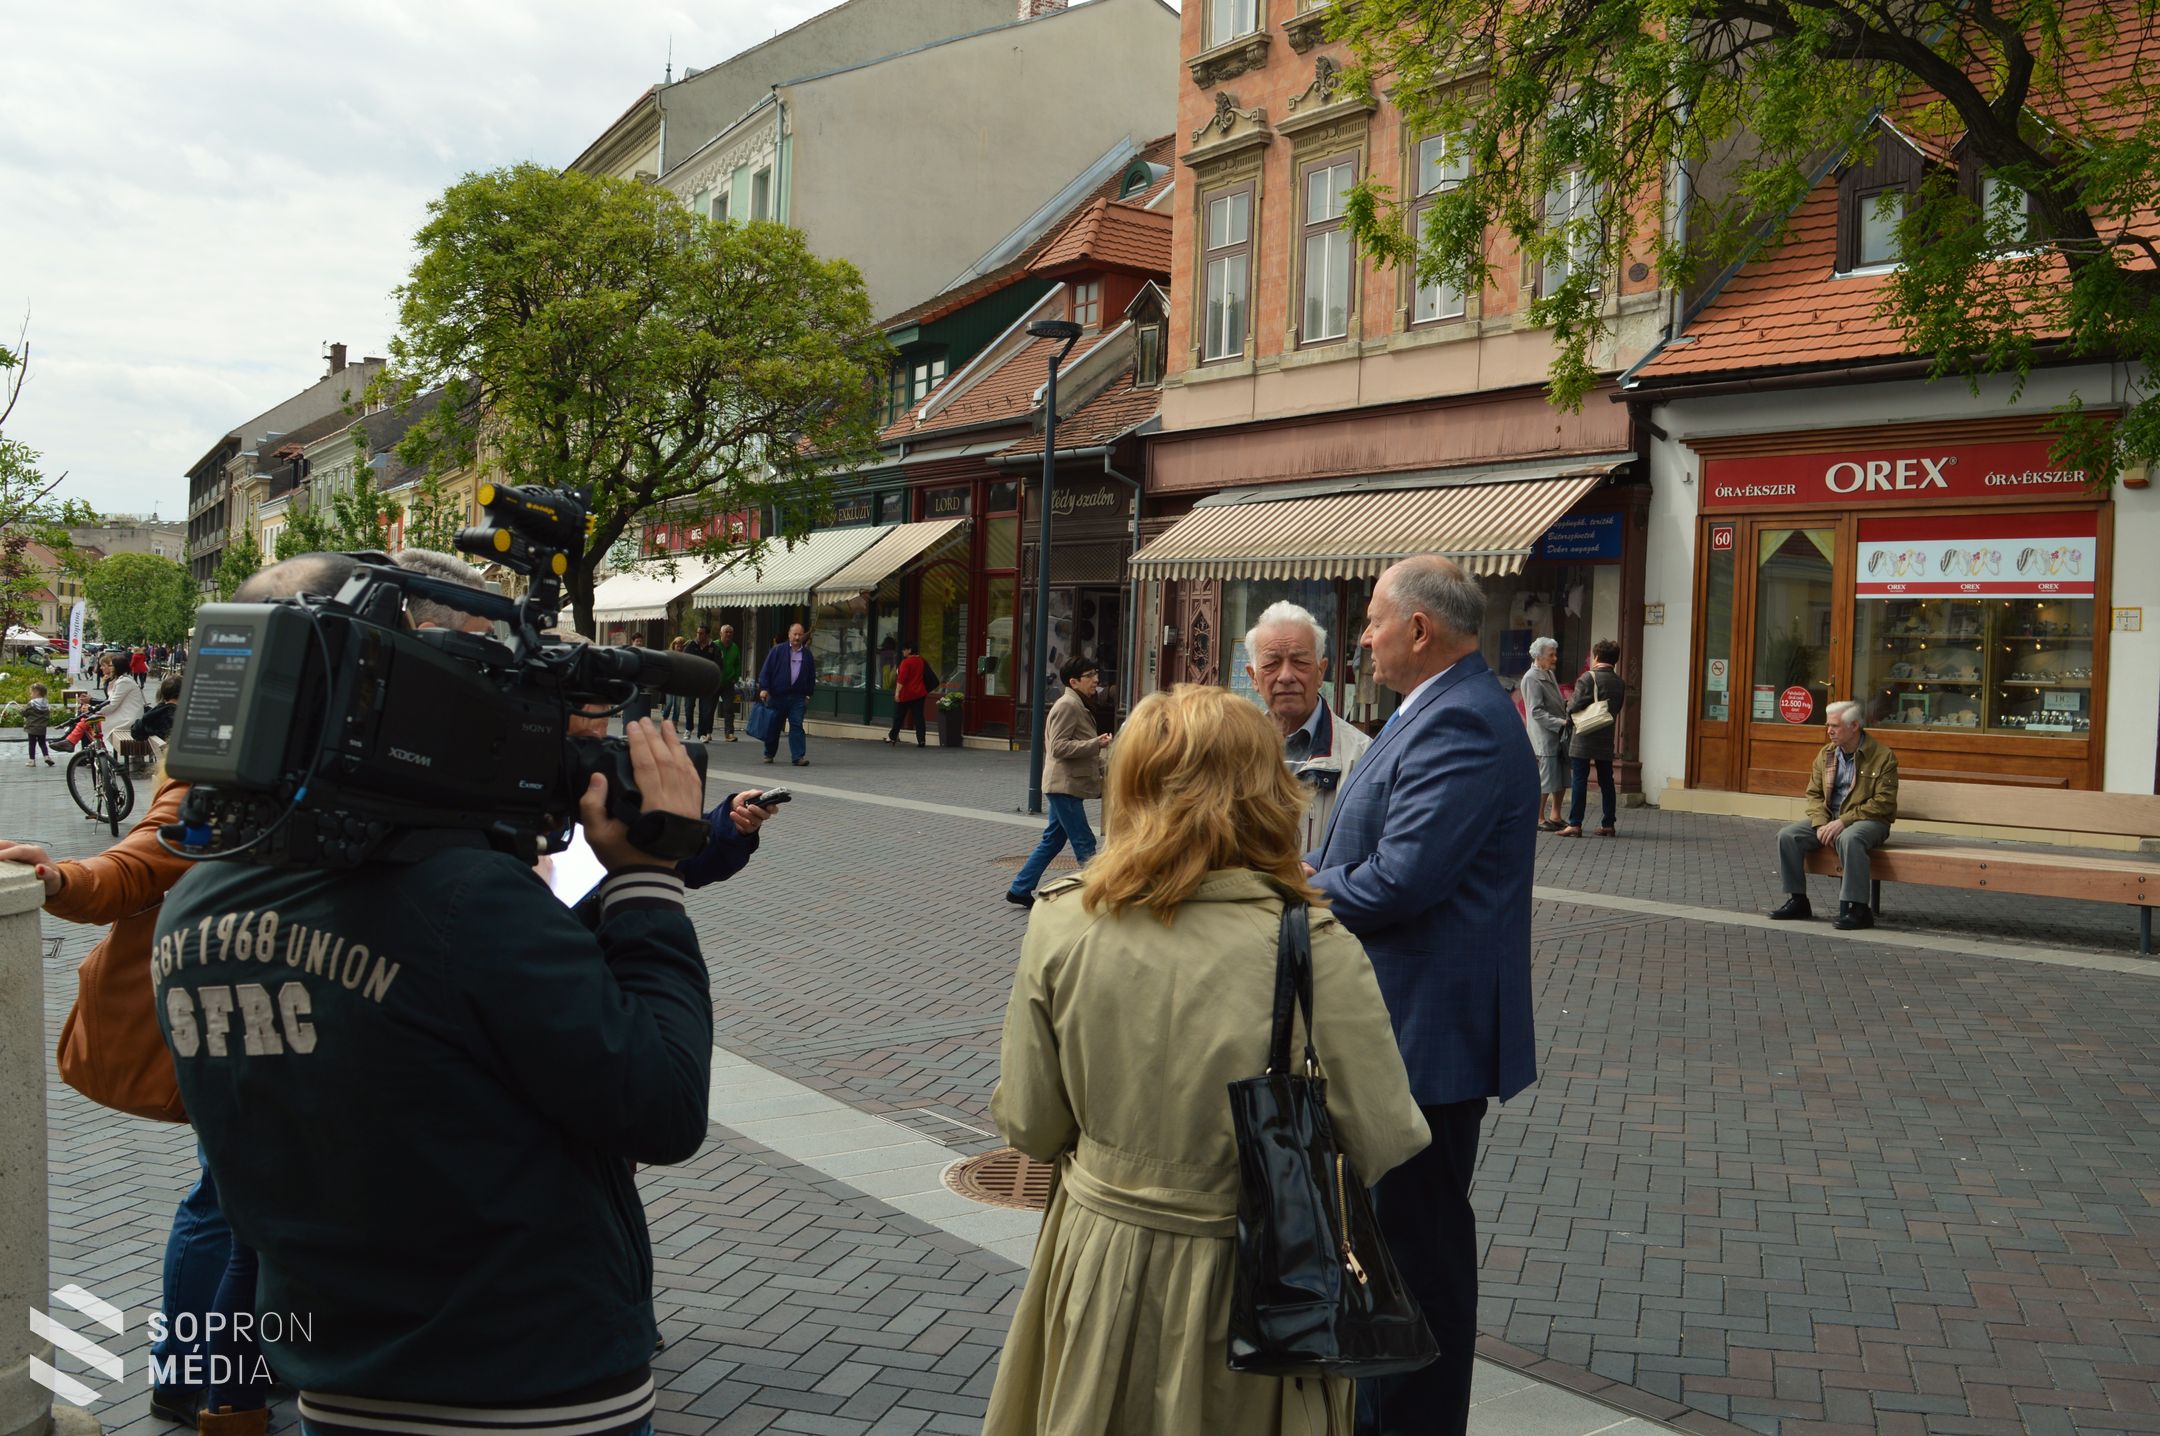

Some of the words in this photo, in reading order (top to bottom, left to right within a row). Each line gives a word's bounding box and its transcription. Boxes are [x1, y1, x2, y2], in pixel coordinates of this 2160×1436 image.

[1984, 470, 2085, 486] ÓRA-ÉKSZER
[1076, 486, 1115, 507] szalon
[1715, 482, 1796, 498] ÓRA-ÉKSZER
[935, 496, 960, 512] LORD
[1715, 532, 1730, 545] 60
[1781, 699, 1802, 708] 12.500
[521, 722, 553, 735] SONY
[388, 747, 433, 768] XDCAM
[150, 928, 189, 986] GBY
[197, 910, 280, 965] 1968
[286, 923, 401, 1004] UNION
[166, 981, 318, 1058] SFRC
